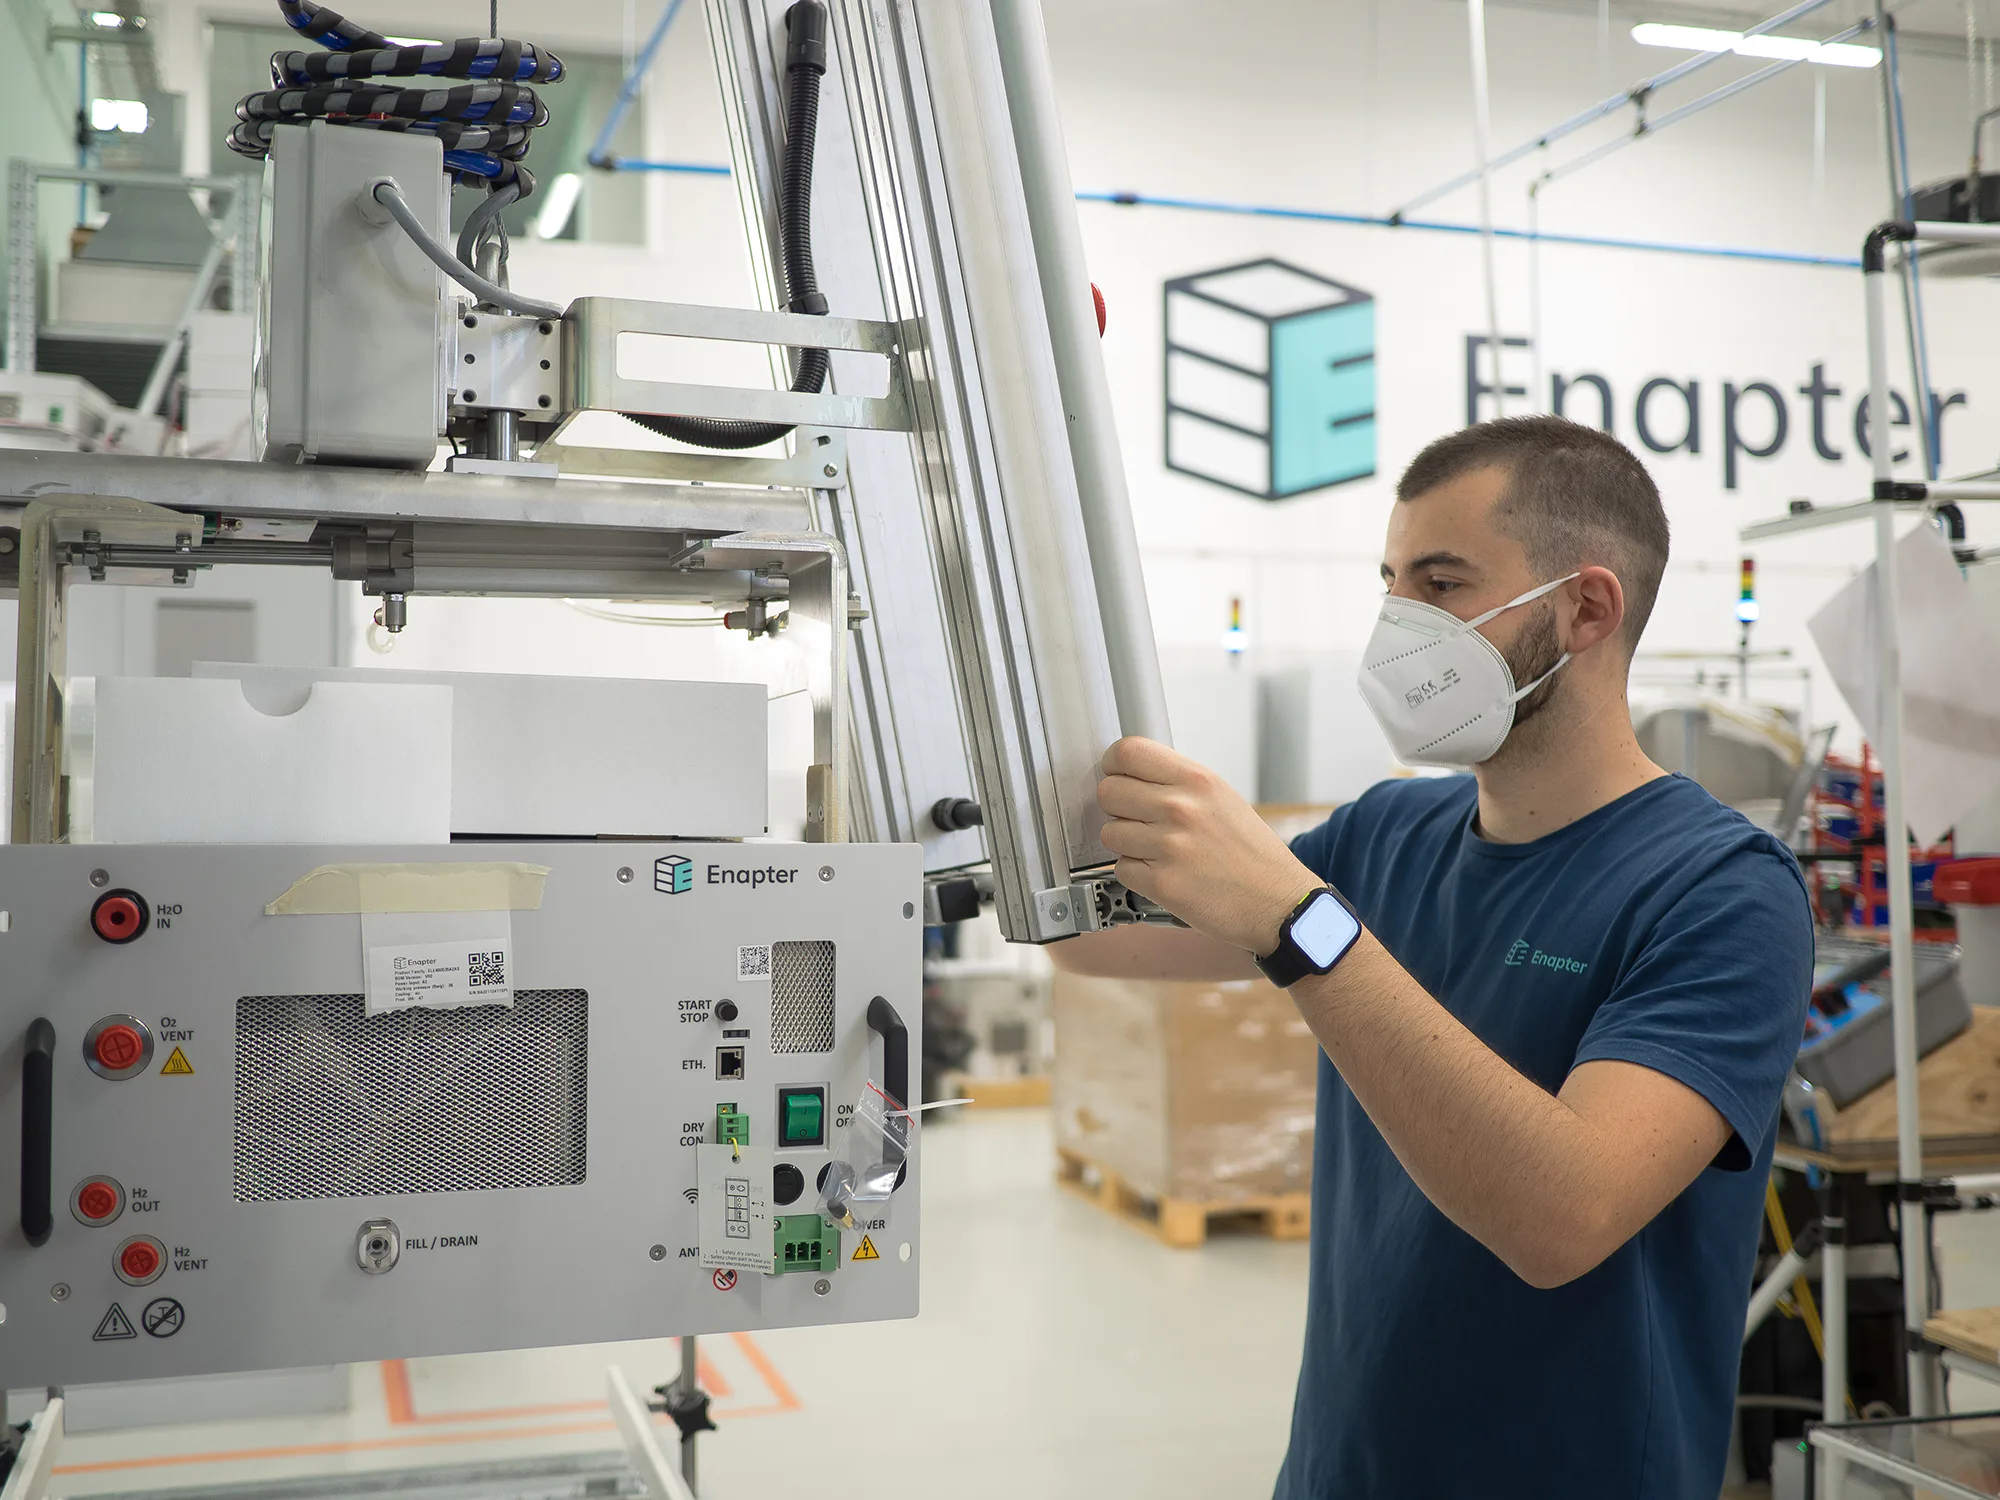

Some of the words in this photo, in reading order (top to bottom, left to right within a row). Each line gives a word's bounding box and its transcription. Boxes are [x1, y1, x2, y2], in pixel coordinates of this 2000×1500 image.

[1463, 333, 1967, 491] Enapter
[707, 864, 799, 889] Enapter
[156, 917, 171, 929] IN
[407, 958, 437, 967] Enapter
[1531, 949, 1588, 974] Enapter
[678, 1000, 712, 1012] START
[160, 1016, 178, 1029] O2
[680, 1012, 710, 1024] STOP
[160, 1029, 194, 1042] VENT
[682, 1059, 706, 1070] ETH.
[837, 1104, 854, 1115] ON
[683, 1122, 705, 1133] DRY
[132, 1187, 148, 1199] H2
[131, 1199, 161, 1213] OUT
[847, 1219, 886, 1231] OWER
[405, 1236, 428, 1250] FILL
[440, 1234, 478, 1248] DRAIN
[174, 1246, 190, 1258] H2
[174, 1257, 208, 1271] VENT
